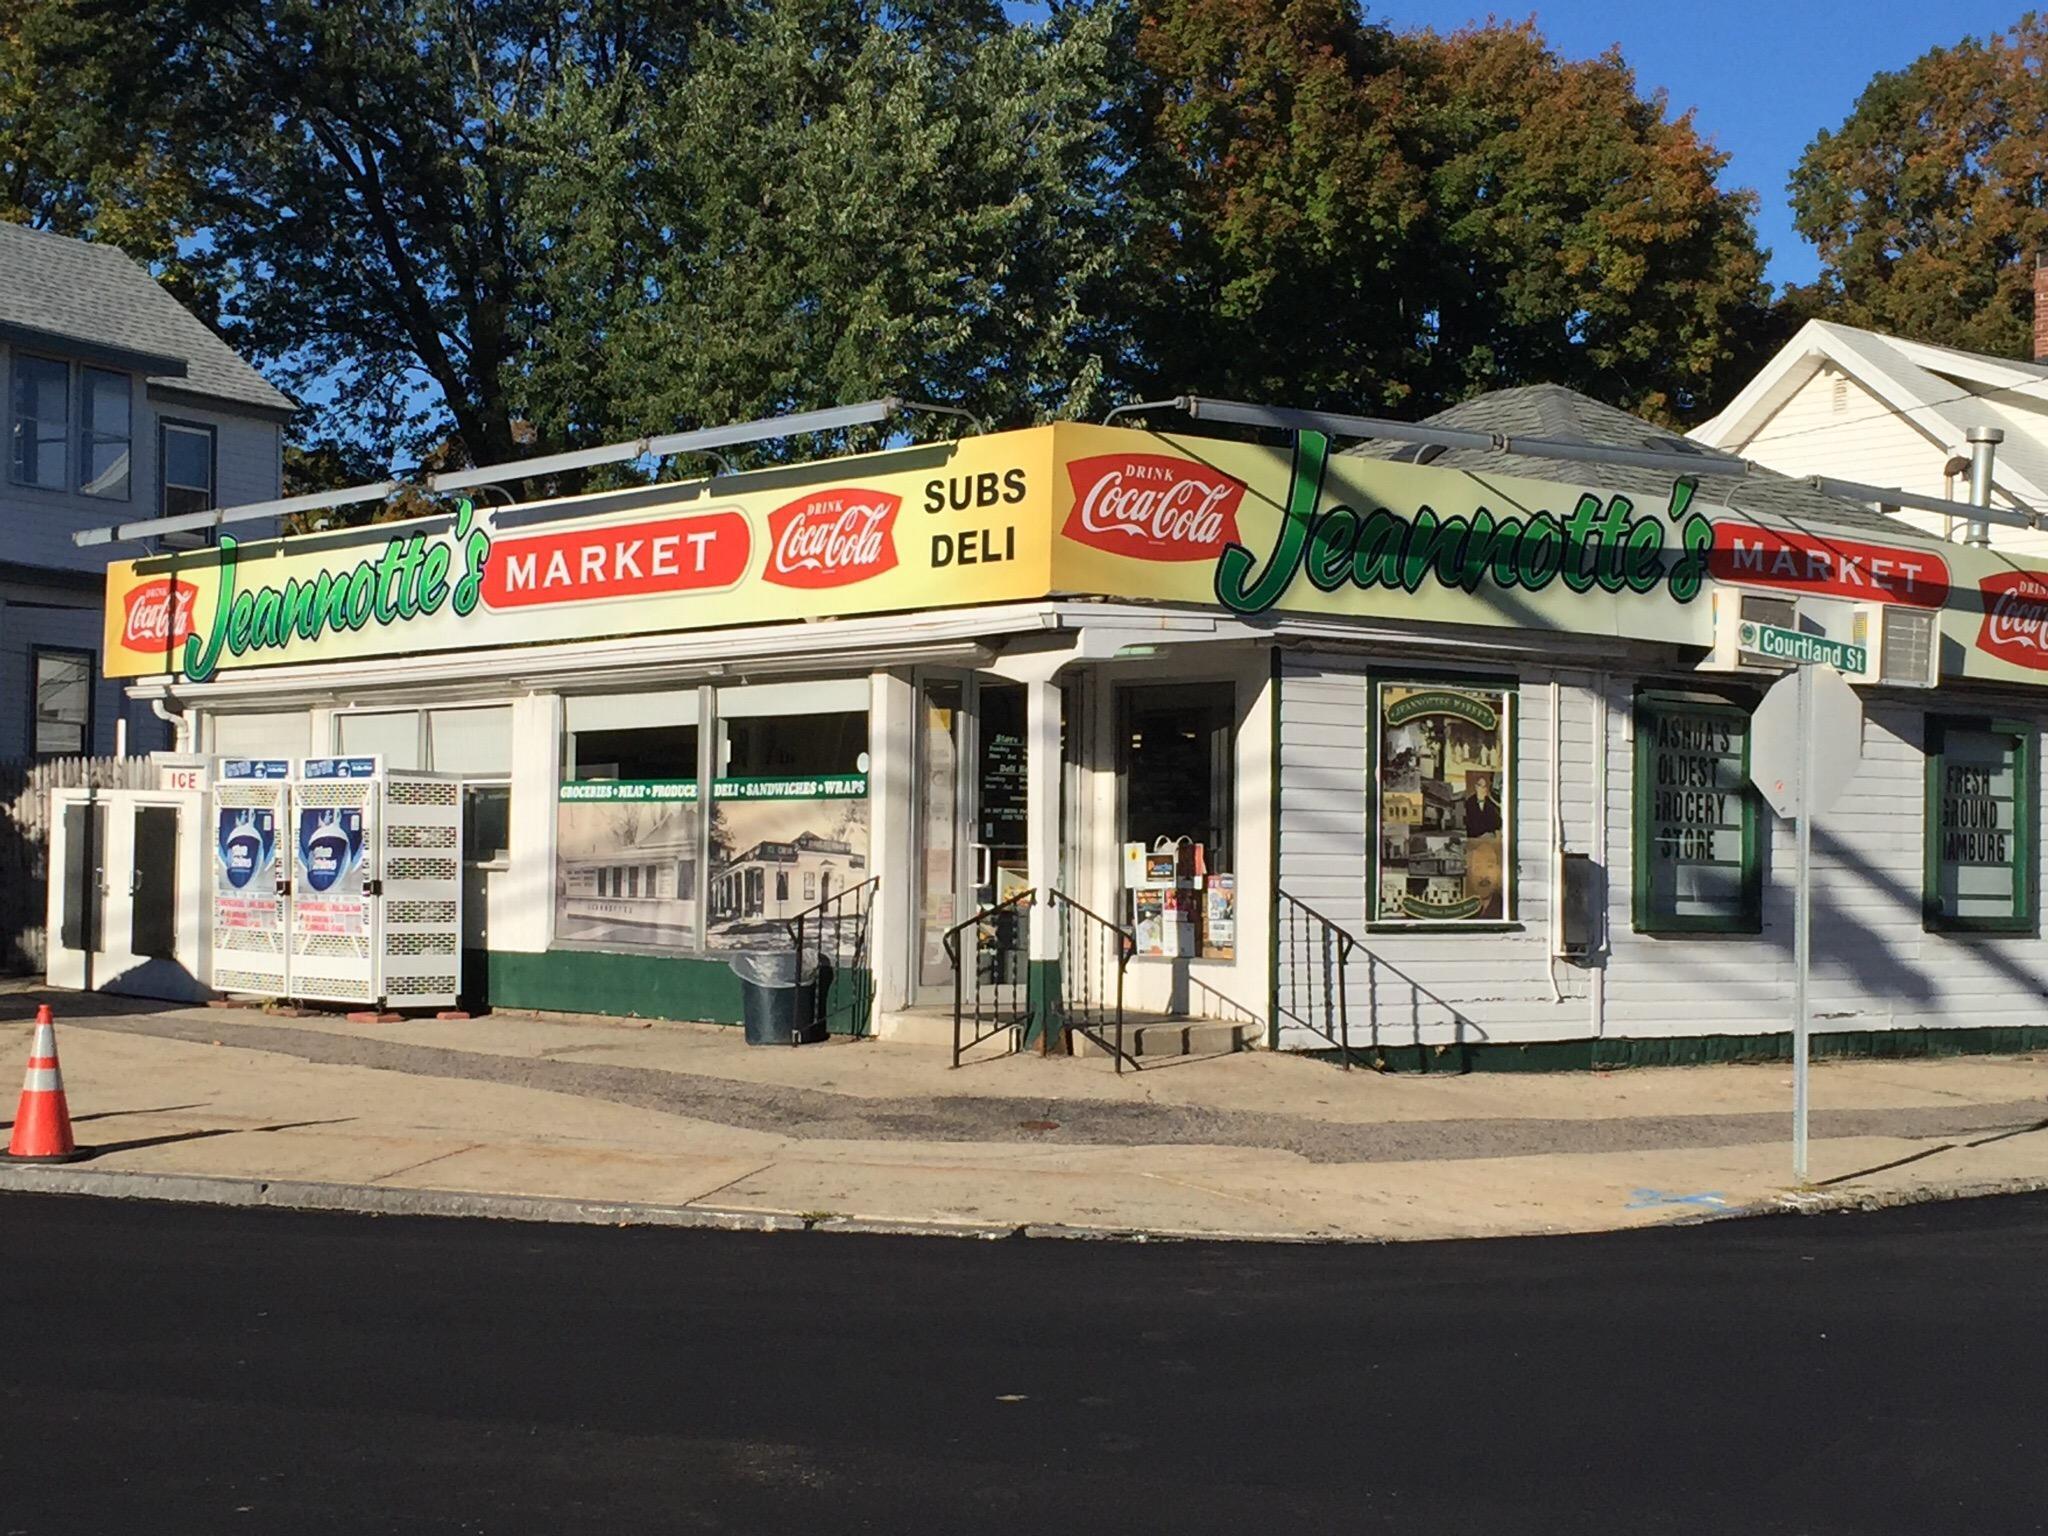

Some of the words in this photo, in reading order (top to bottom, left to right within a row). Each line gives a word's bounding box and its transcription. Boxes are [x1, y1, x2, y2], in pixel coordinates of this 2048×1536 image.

[923, 467, 1028, 514] SUBS
[1125, 463, 1174, 482] DRINK
[807, 499, 843, 516] DRINK
[1082, 471, 1234, 546] Coca-Cola
[1214, 429, 1713, 616] Jeannotte's
[776, 497, 892, 574] Coca-Cola
[931, 526, 1016, 568] DELI
[505, 531, 718, 593] MARKET
[1731, 538, 1923, 594] MARKET
[184, 496, 491, 682] Jeannotte's
[127, 590, 193, 641] Coca-Cola
[1763, 629, 1842, 667] Courtland
[1846, 648, 1864, 672] St
[171, 771, 197, 790] ICE
[560, 785, 613, 799] GROCERIES
[618, 784, 647, 798] MEAT
[652, 784, 697, 798] PRODUCE
[714, 783, 739, 797] DELI
[746, 780, 817, 796] SANDWICHES
[824, 780, 866, 795] WRAPS
[1658, 752, 1720, 789] OLDEST
[1948, 764, 1990, 796] FRESH
[1661, 826, 1715, 861] STORE
